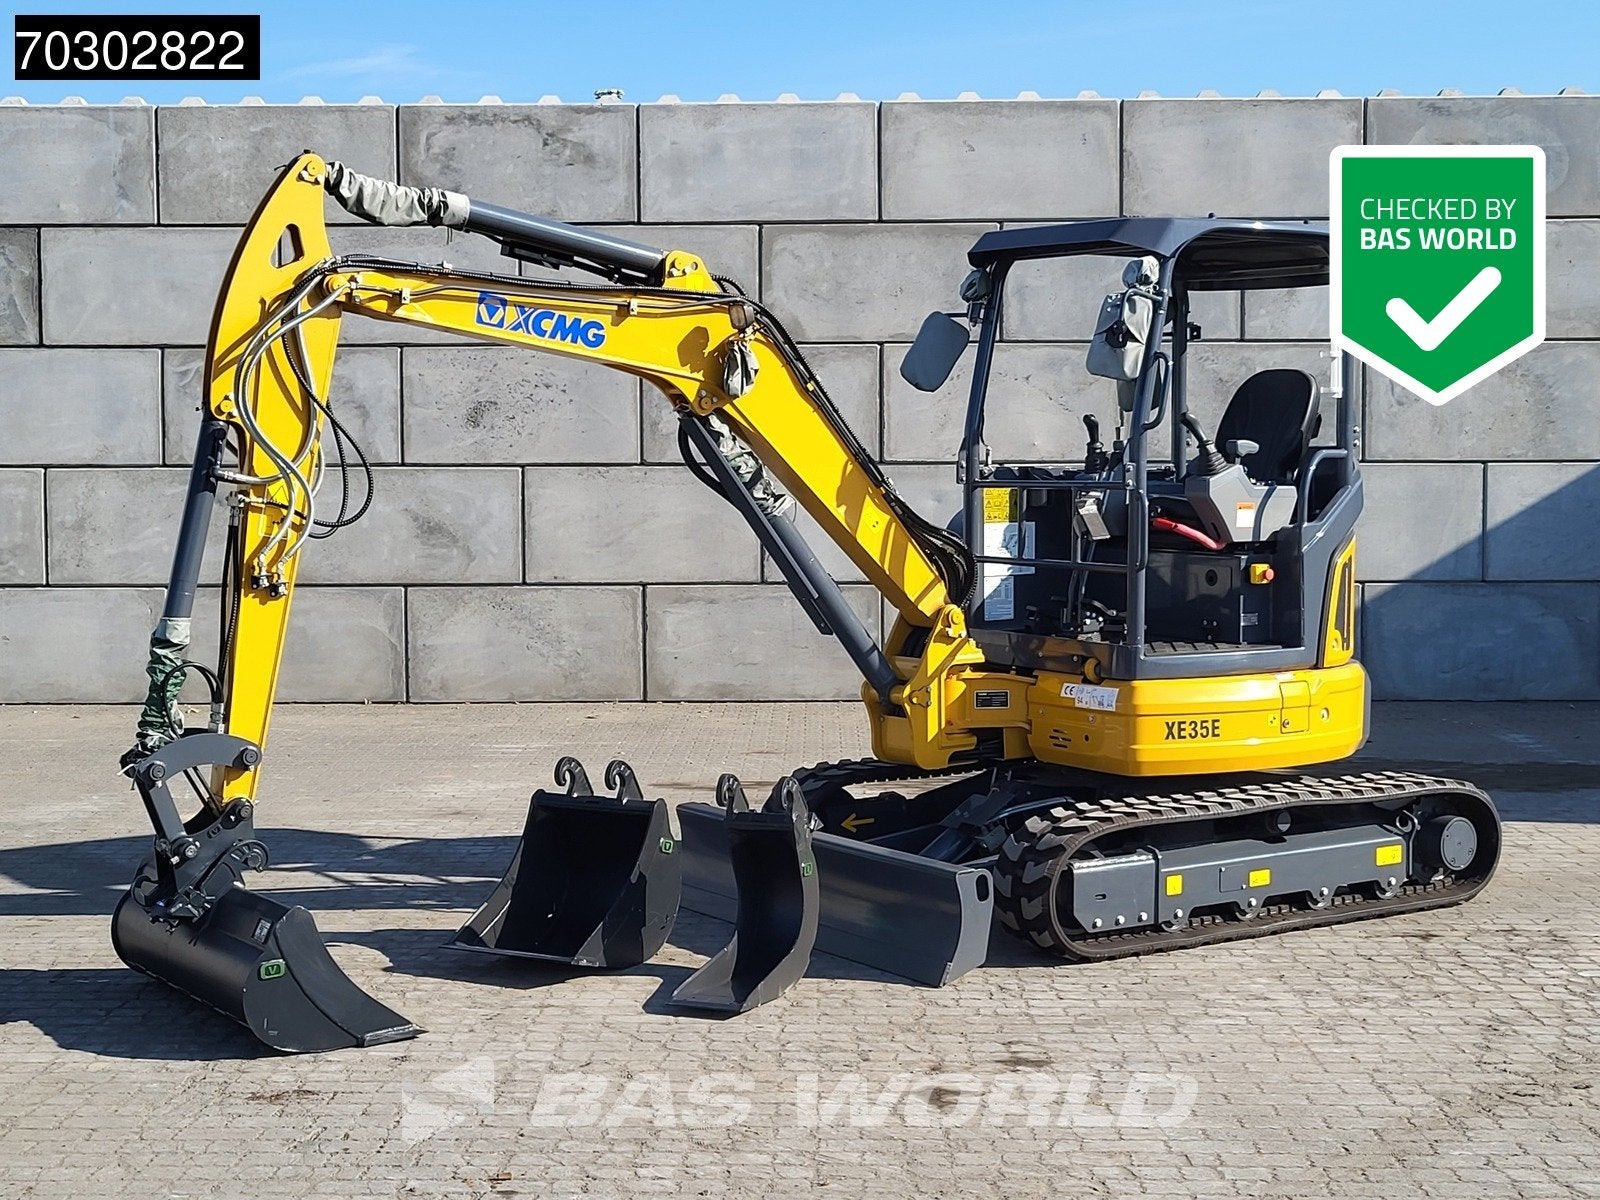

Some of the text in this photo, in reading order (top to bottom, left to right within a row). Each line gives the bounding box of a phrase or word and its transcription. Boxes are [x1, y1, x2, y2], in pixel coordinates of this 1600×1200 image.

[504, 304, 606, 349] XCMG
[1064, 685, 1076, 696] CE
[1164, 718, 1221, 741] XE35E
